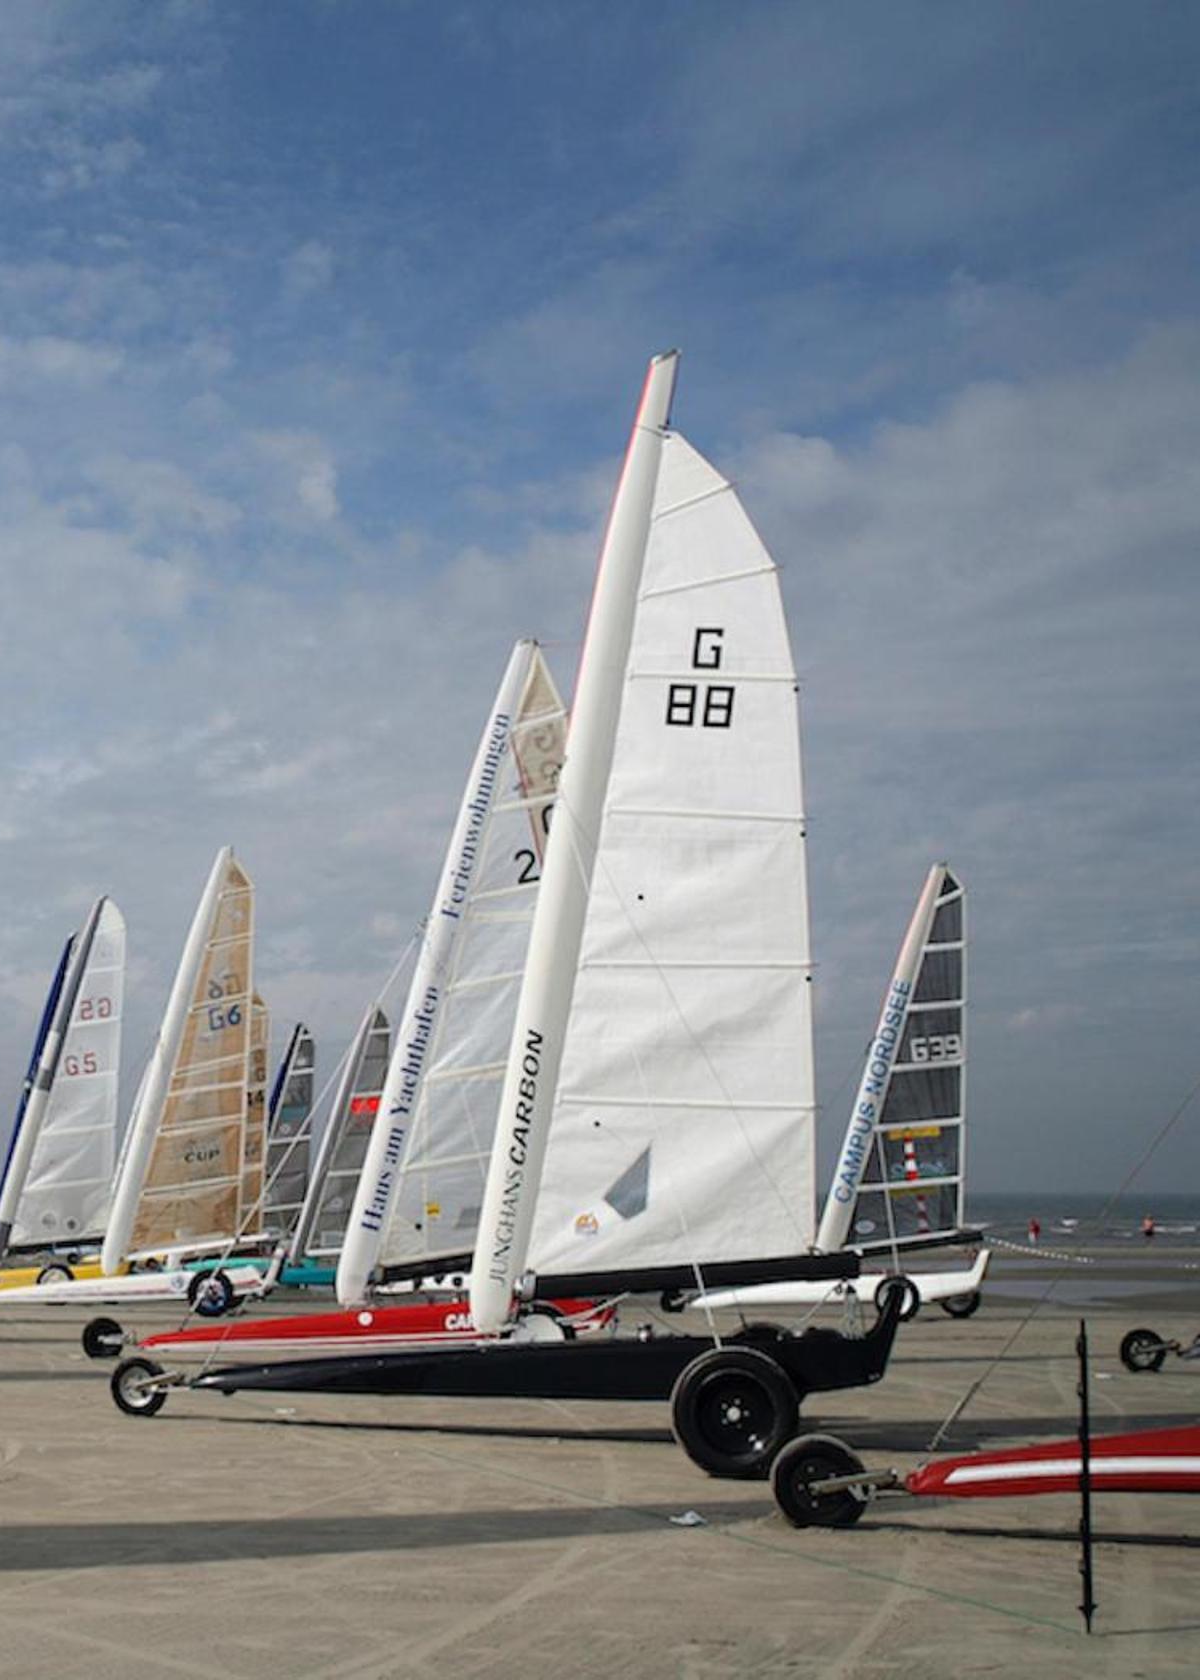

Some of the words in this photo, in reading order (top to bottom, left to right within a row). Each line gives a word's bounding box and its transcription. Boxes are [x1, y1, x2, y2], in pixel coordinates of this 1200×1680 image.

[692, 628, 724, 669] G
[666, 684, 735, 728] 88
[441, 713, 510, 919] Ferienwohnungen
[390, 986, 438, 1117] Yachthafen
[834, 1104, 875, 1204] CAMPUS
[864, 979, 912, 1098] NORDSEE
[910, 1034, 962, 1062] G39
[383, 1126, 404, 1167] am
[489, 1168, 525, 1288] JUNGHANS
[510, 1029, 544, 1169] CARBON
